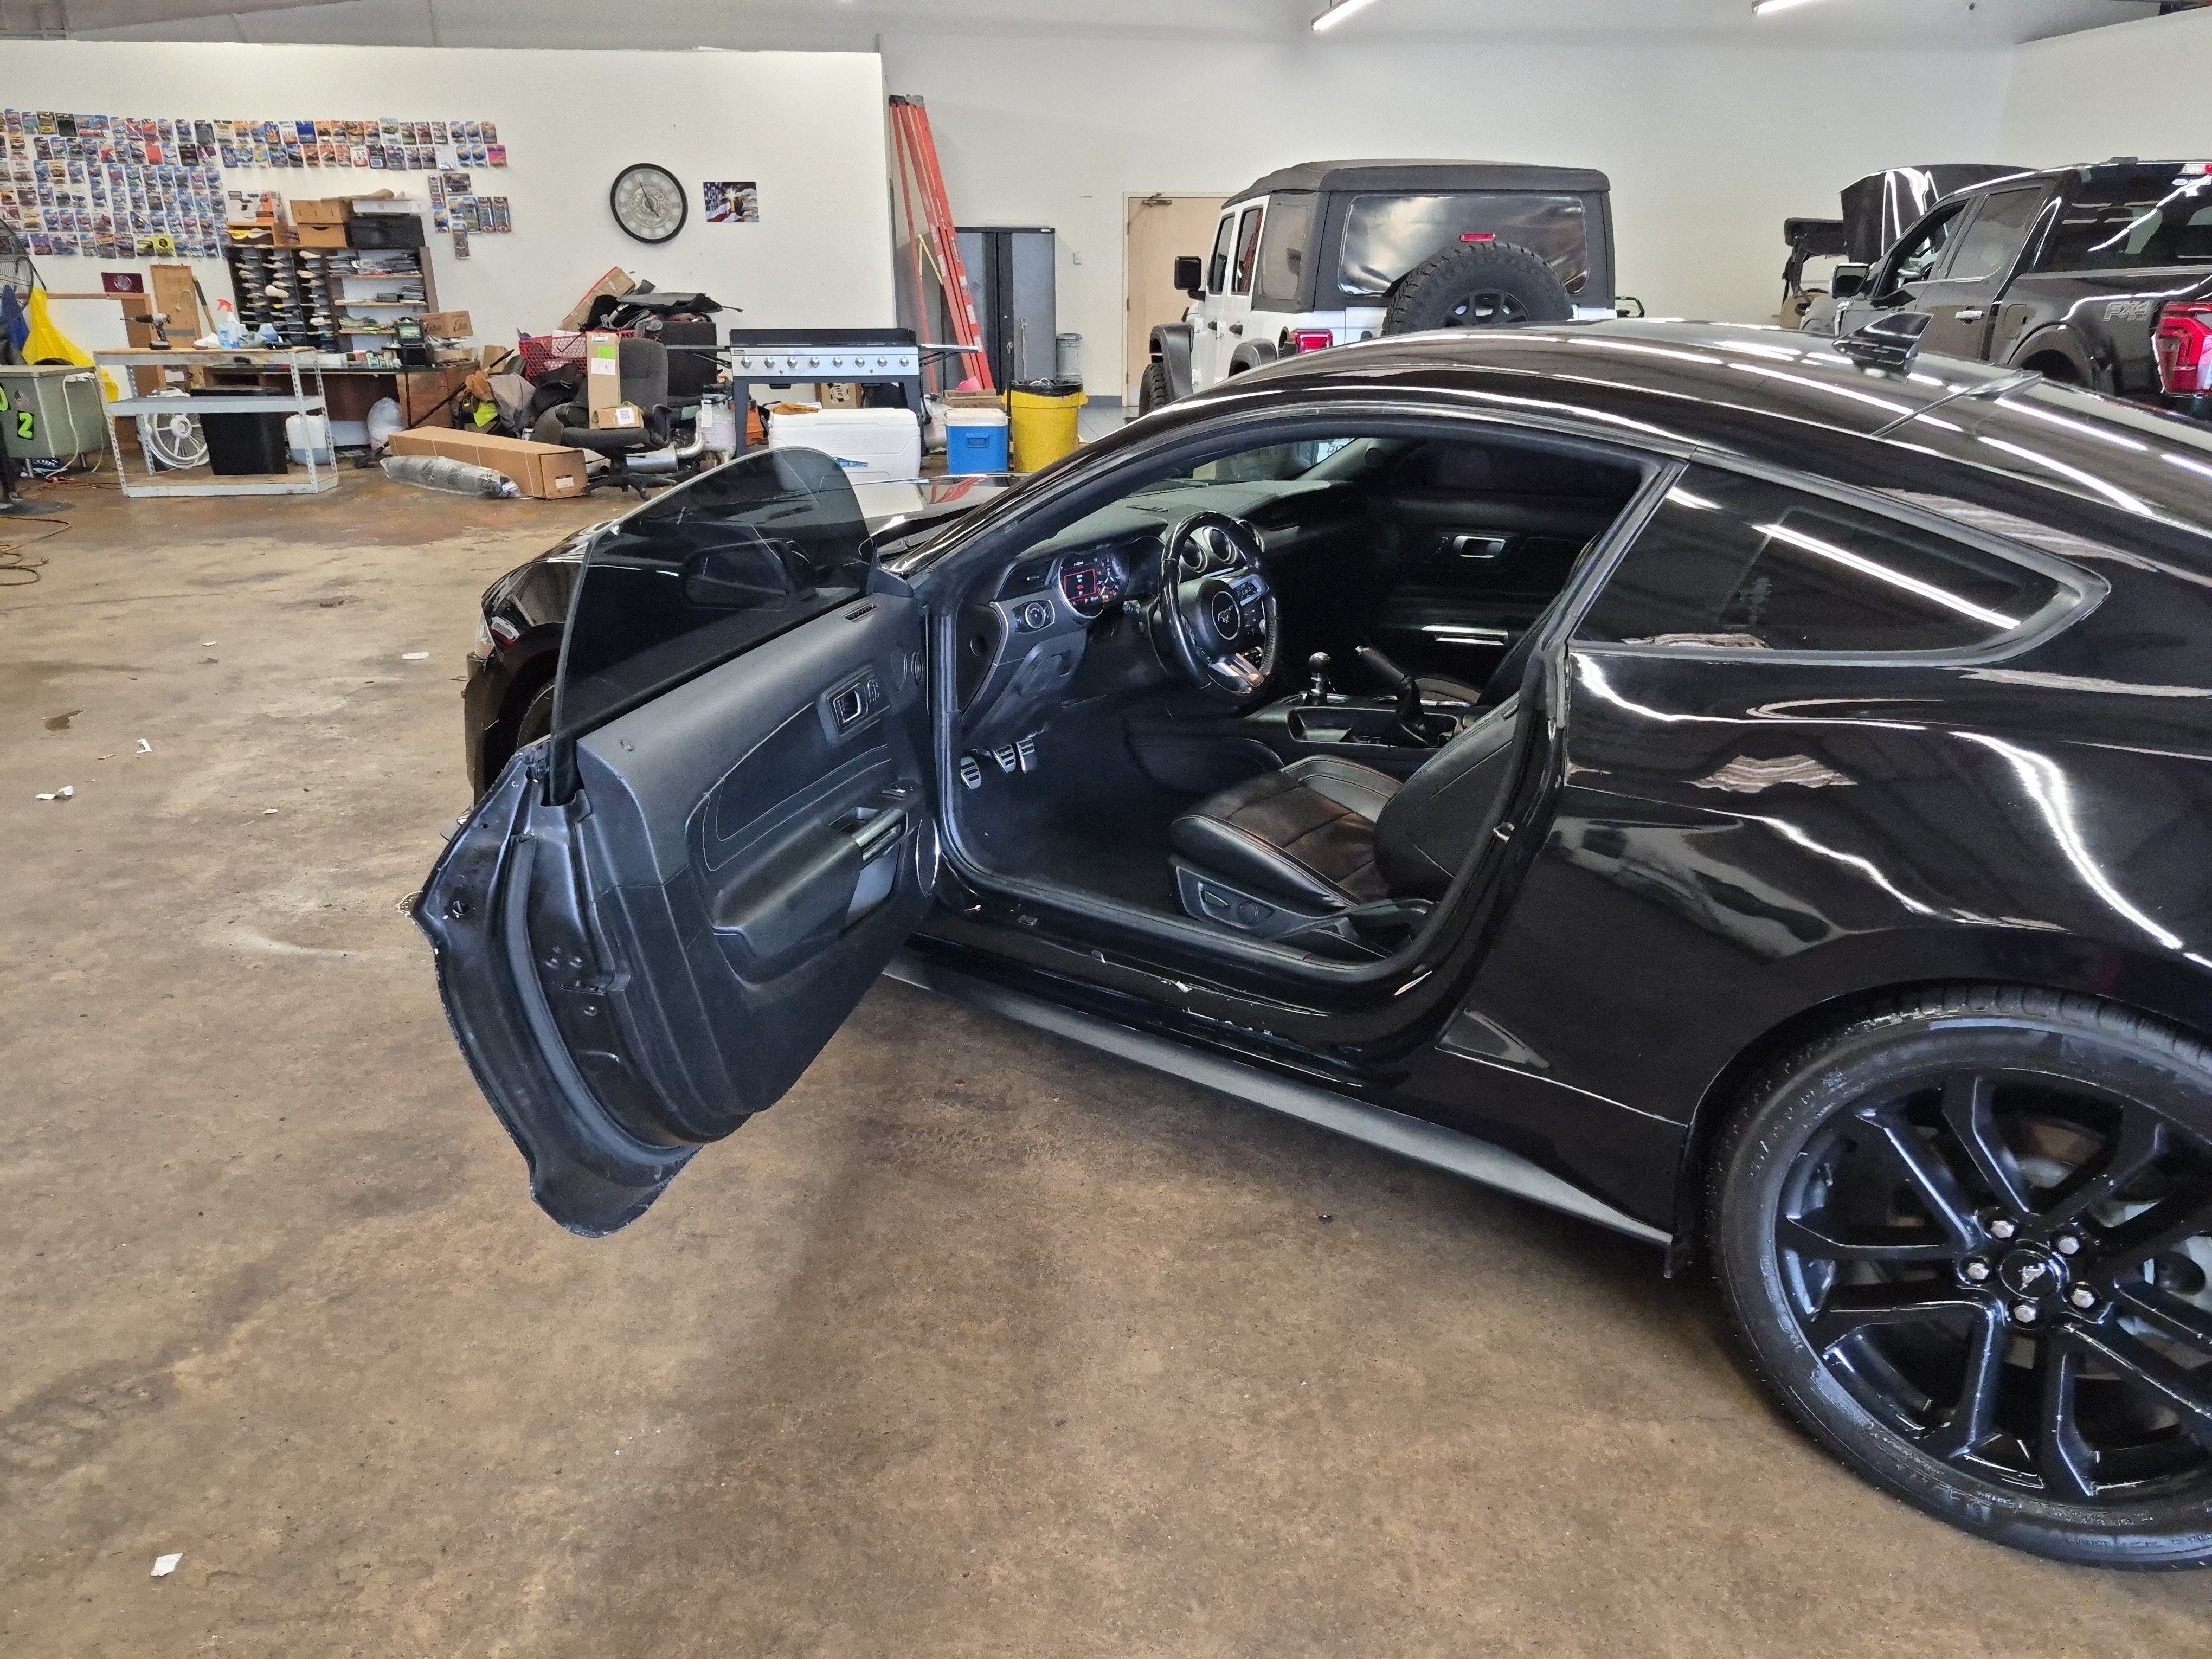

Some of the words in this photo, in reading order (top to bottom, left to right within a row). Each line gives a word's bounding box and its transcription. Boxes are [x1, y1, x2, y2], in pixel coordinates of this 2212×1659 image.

[2102, 300, 2154, 322] FX4
[833, 385, 843, 396] Lite
[18, 412, 33, 439] 2
